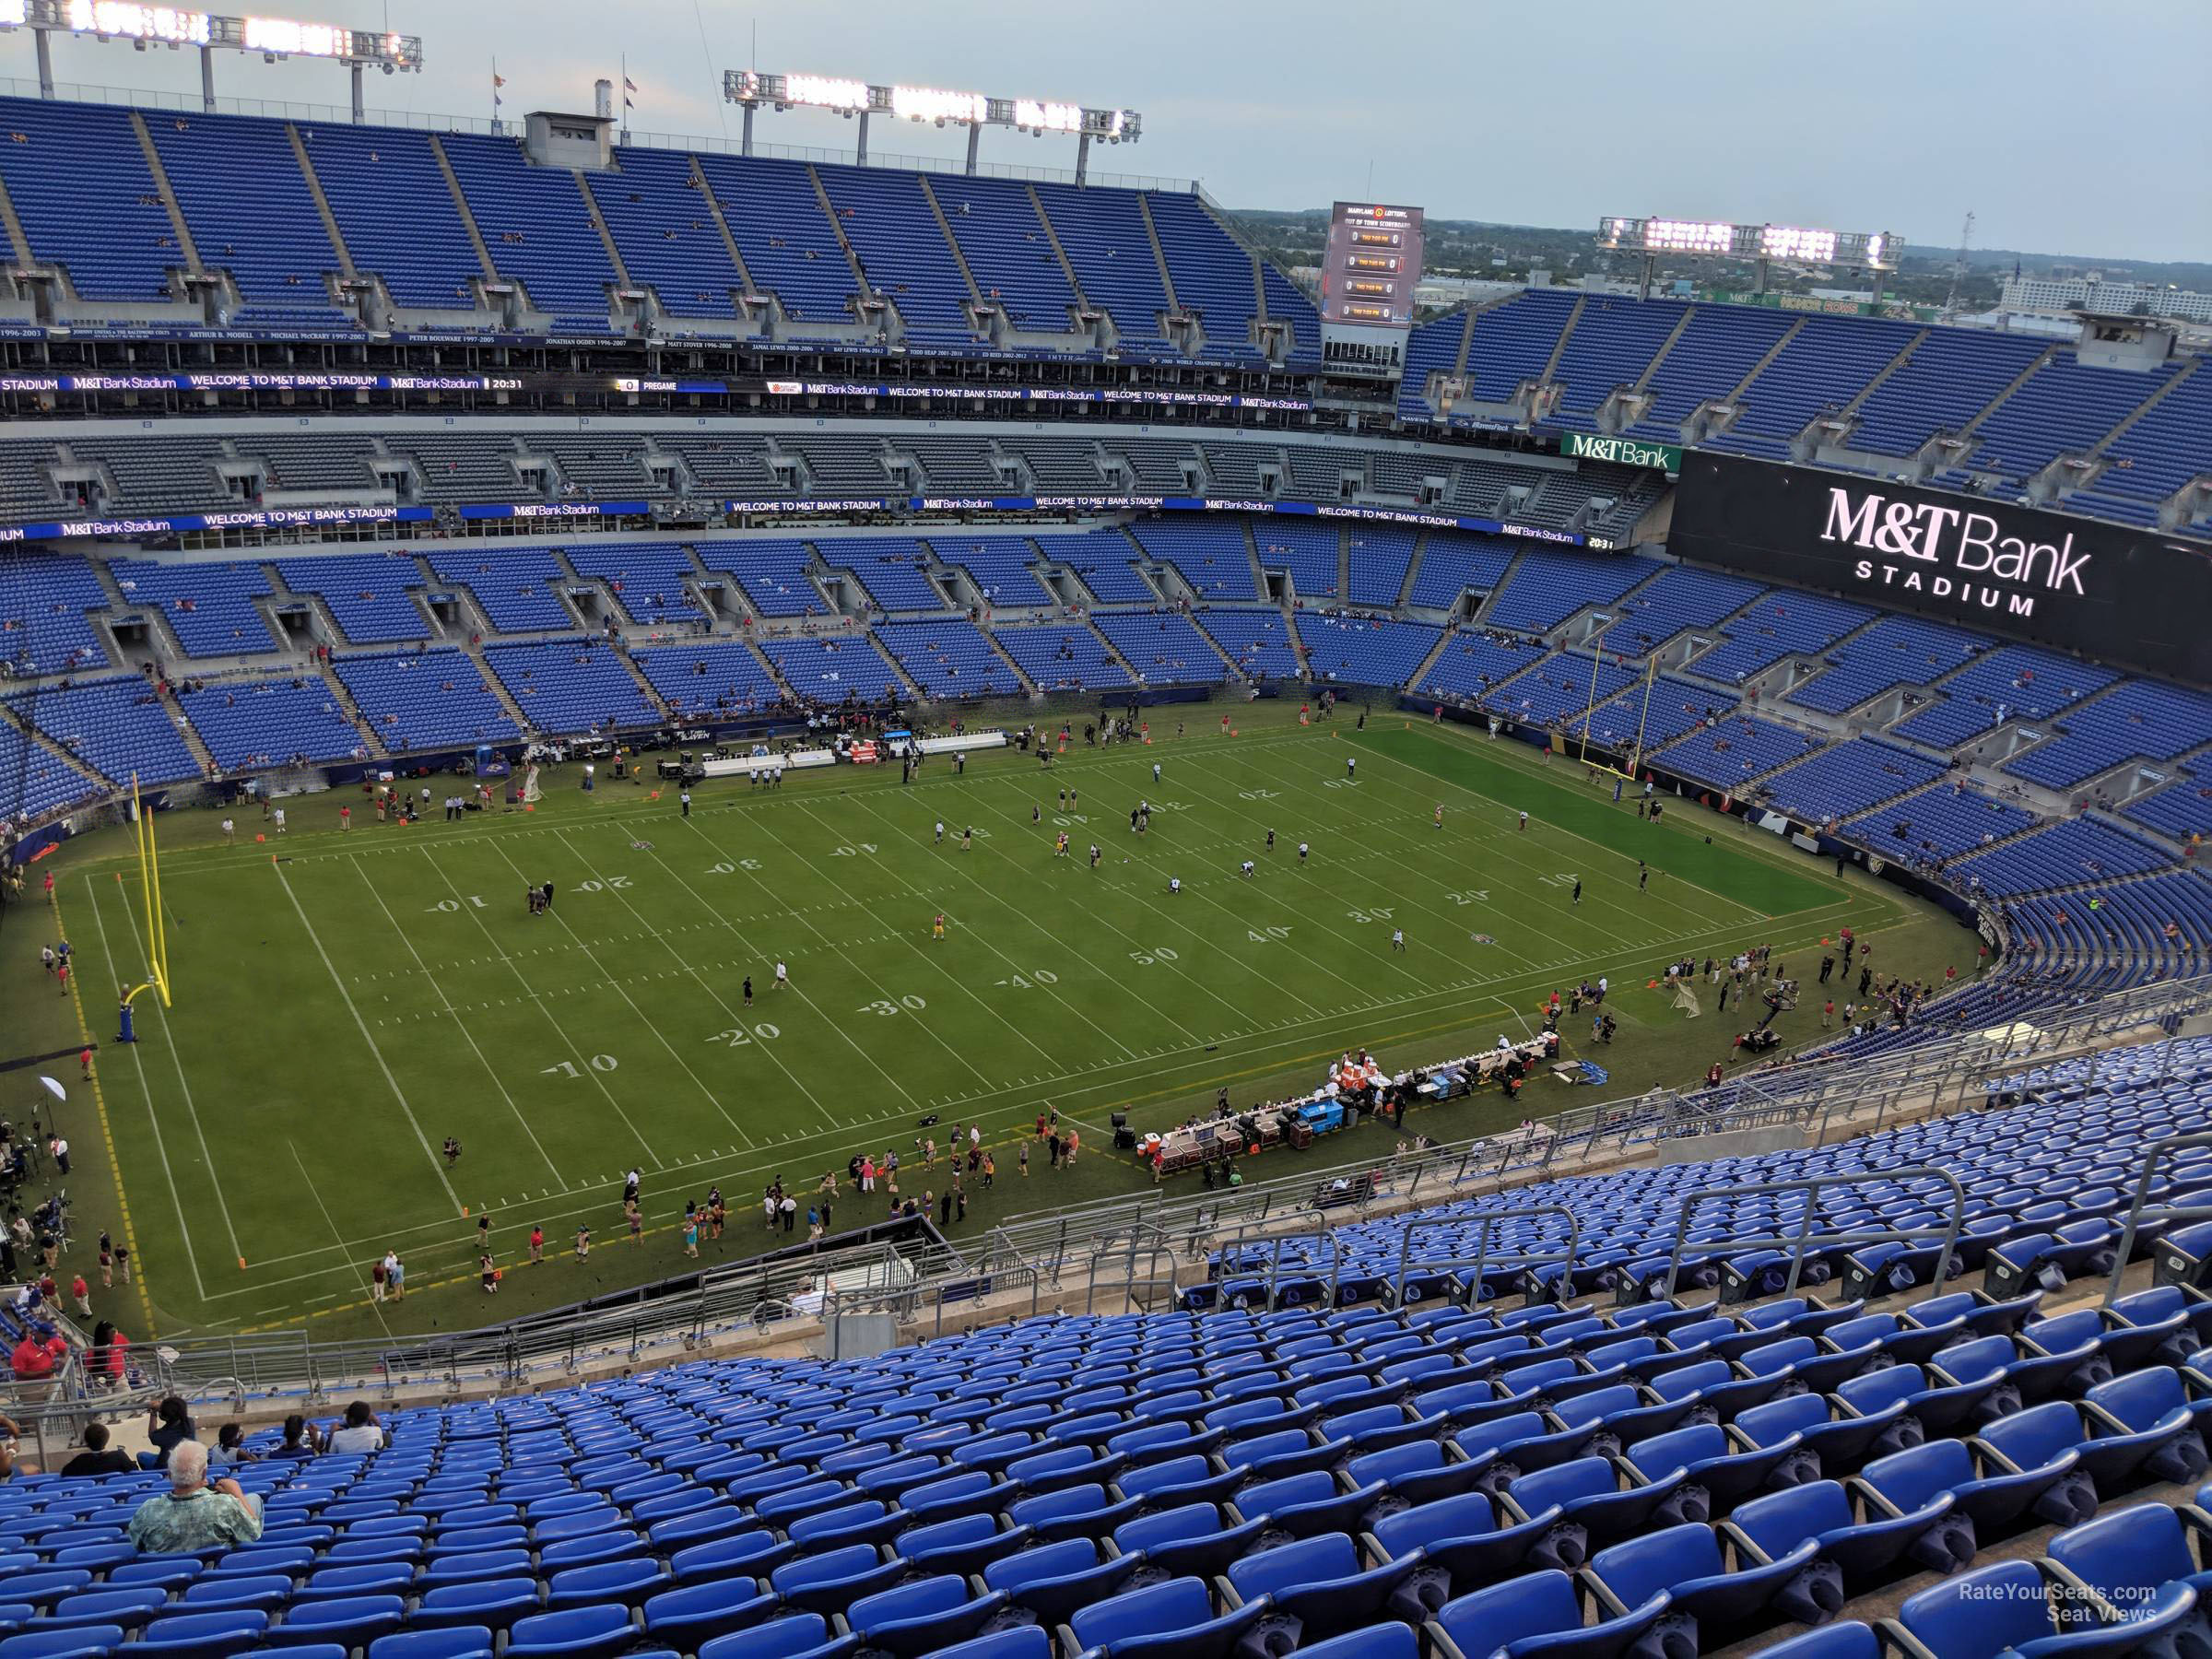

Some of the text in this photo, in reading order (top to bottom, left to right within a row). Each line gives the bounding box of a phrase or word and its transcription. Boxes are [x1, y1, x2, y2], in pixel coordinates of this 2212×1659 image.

[1352, 231, 1358, 241] 0
[1393, 235, 1398, 243] 0
[1349, 256, 1355, 265] 0
[1390, 259, 1395, 268] 0
[1347, 281, 1352, 290] 0
[1386, 284, 1392, 292] 0
[1780, 296, 1821, 312] HONOR
[1824, 299, 1858, 313] ROWS
[1344, 306, 1349, 314] 0
[1383, 309, 1389, 317] 0
[2, 380, 58, 390] STADIUM
[74, 377, 176, 389] M&T Bank Stadium
[191, 376, 378, 385] WELCOME TO M&T BANK STADIUM
[391, 378, 478, 389] M&T Bank Stadium
[492, 380, 522, 388] 20:31
[627, 382, 633, 390] 0
[644, 382, 677, 391] PREGAME
[807, 384, 828, 394] M&T
[829, 384, 847, 394] Bank
[848, 385, 878, 395] Stadium
[888, 388, 1021, 399] WELCOME TO M&T BANK STADIUM
[1030, 389, 1094, 400] M&T Bank Stadium
[1104, 391, 1141, 399] WELCOME
[1197, 394, 1231, 403] STADIUM
[1241, 397, 1308, 410] M&T Bank Stadium
[1472, 422, 1509, 431] #RavensFlock
[1571, 435, 1669, 468] M&T Bank
[734, 500, 880, 512] WELCOME TO M&T BANK STADIUM
[924, 499, 993, 508] M&T Bank Stadium
[1035, 497, 1076, 505] WELCOME
[1206, 500, 1274, 512] M&T Bank Stadium
[205, 508, 396, 524] WELCOME TO M&T BANK STADIUM
[514, 504, 599, 516] M&T Bank Stadium
[1318, 507, 1457, 527] WELCOME TO M&T BANK STADIUM
[63, 520, 170, 536] M&T Bank Stadium
[1501, 524, 1572, 543] M&T Bank Stadium
[1589, 537, 1614, 549] 20:31
[1820, 488, 2092, 594] M&T Bank
[1855, 560, 2034, 617] STADIUM
[1053, 814, 1088, 827] 40
[836, 843, 877, 856] 40
[714, 858, 763, 873] 30
[582, 876, 633, 892] 20
[1537, 874, 1578, 887] 10
[438, 895, 488, 912] 10
[1445, 889, 1489, 905] 20
[1347, 907, 1394, 924] 30
[1247, 926, 1289, 944] 40
[1129, 947, 1179, 965] 50
[1013, 970, 1058, 989] 40
[870, 994, 927, 1016] 30
[719, 1022, 781, 1047] 20
[556, 1053, 618, 1079] 10
